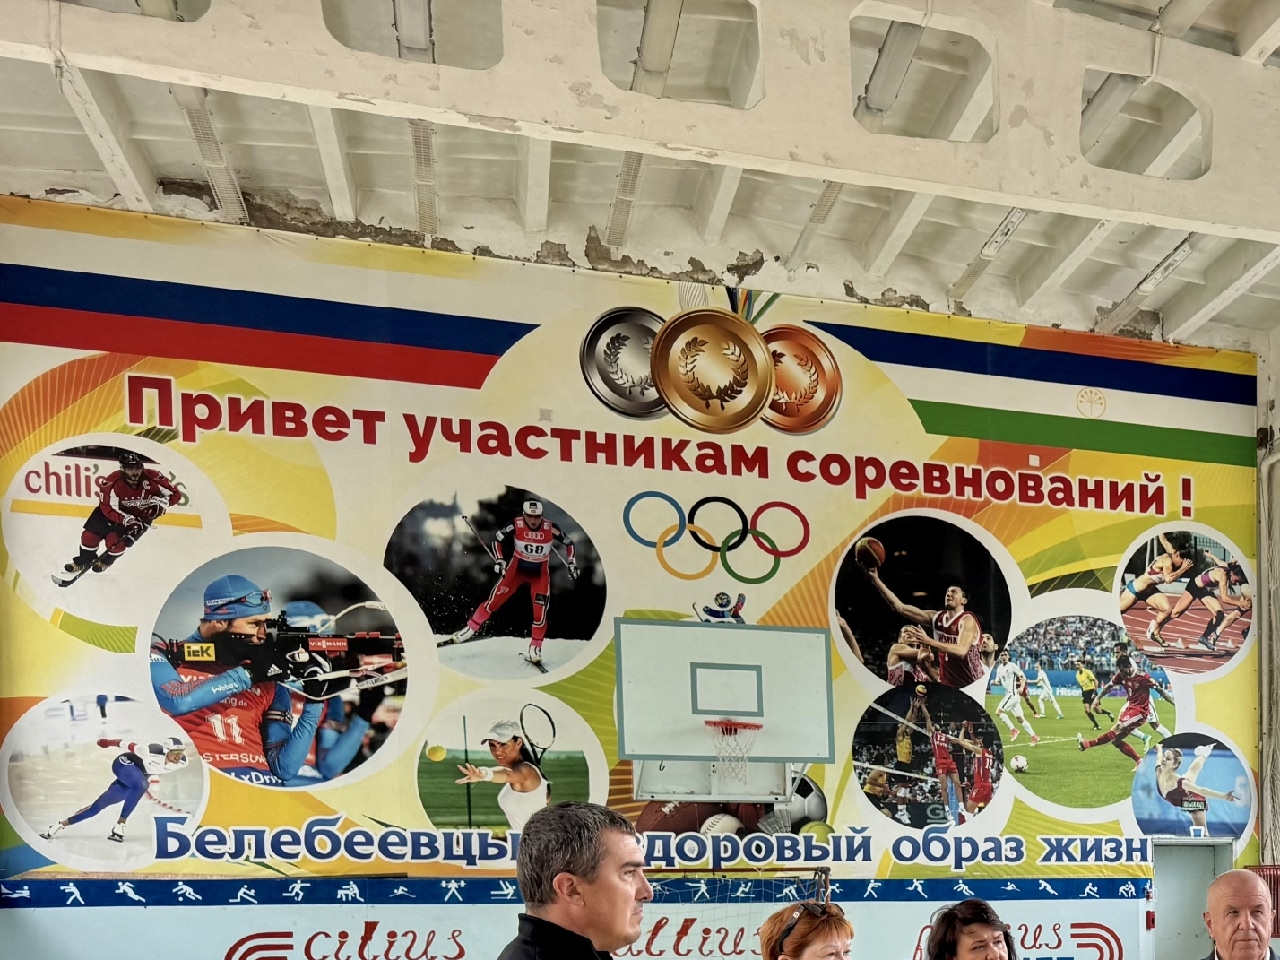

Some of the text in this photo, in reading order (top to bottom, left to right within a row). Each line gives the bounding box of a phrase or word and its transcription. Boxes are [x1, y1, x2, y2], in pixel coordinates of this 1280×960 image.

[128, 376, 1193, 517] Привет участникам соревнований !
[523, 543, 544, 555] 68
[205, 713, 245, 745] 11
[1183, 800, 1205, 809] ВЫХОД
[153, 815, 1152, 869] Белебеевцы доровый образ жизн
